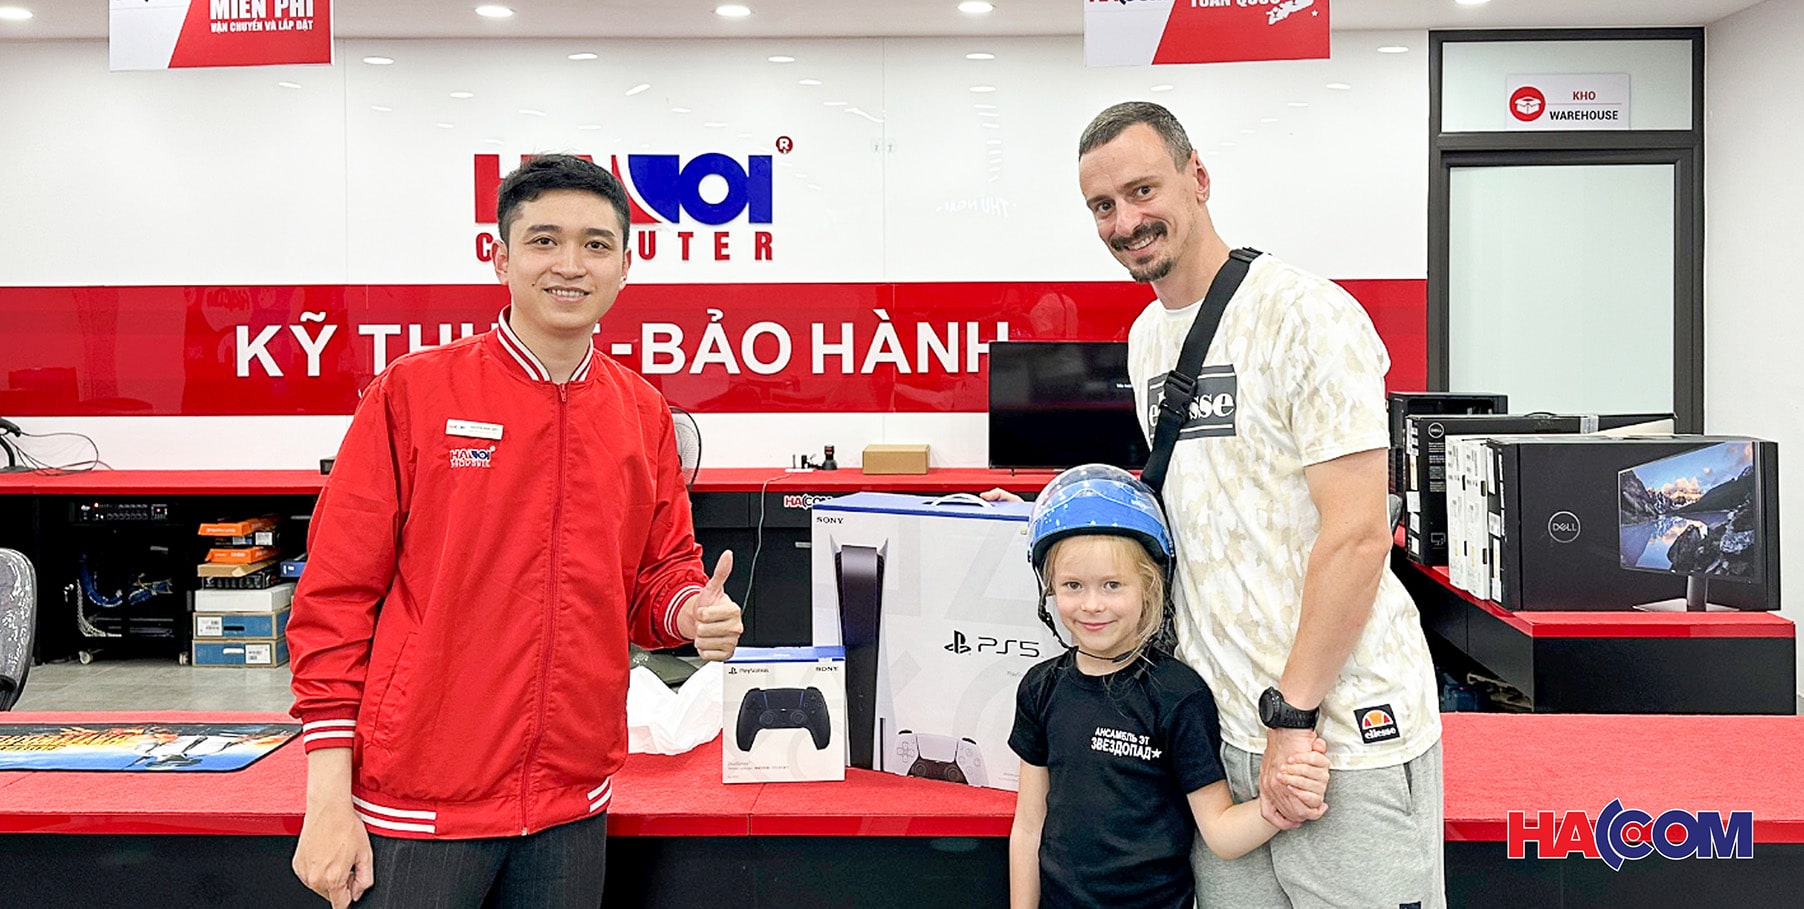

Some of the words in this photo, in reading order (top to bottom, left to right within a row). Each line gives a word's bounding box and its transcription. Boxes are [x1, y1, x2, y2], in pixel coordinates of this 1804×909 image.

[1572, 91, 1596, 101] KHO
[1549, 110, 1619, 121] WAREHOUSE
[475, 230, 773, 262] CUTER
[235, 311, 338, 378] KỸ
[811, 308, 1010, 374] HÀNH
[816, 516, 844, 525] SONY
[1552, 522, 1577, 532] DELL
[977, 636, 1040, 658] PS5
[1094, 726, 1138, 743] АНСАМБЛЬ
[1138, 735, 1150, 746] ЭТ
[1091, 736, 1152, 760] ЗВЕЗДОПАД
